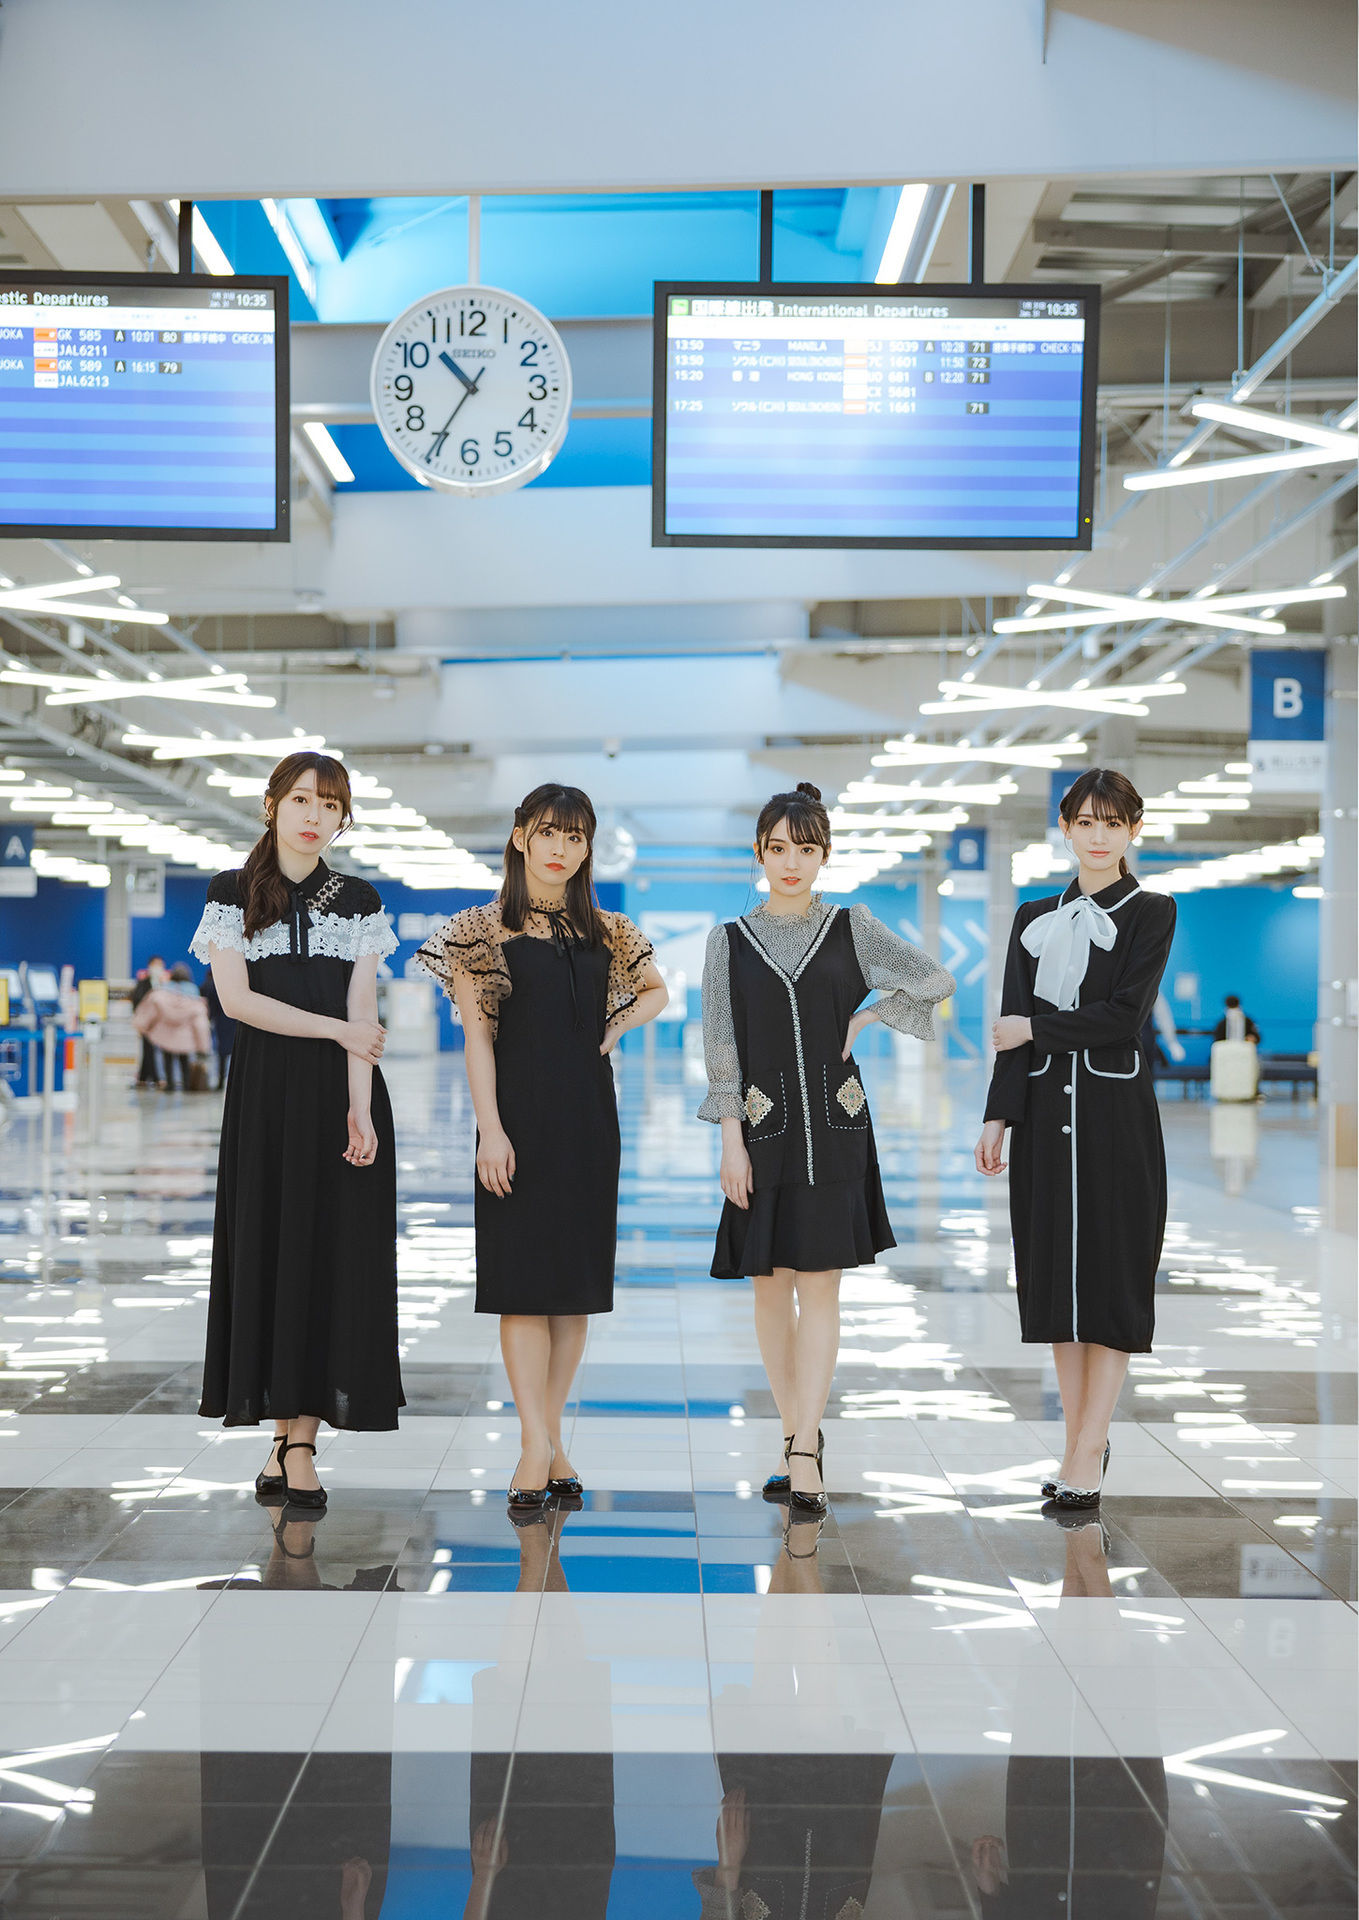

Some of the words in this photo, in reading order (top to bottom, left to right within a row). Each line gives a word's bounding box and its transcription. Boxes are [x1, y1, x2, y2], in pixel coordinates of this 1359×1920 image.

[33, 292, 109, 307] Departures
[236, 294, 267, 307] 10:35
[778, 303, 869, 317] International
[874, 304, 949, 318] Departures
[1047, 303, 1078, 316] 10:35
[460, 310, 487, 336] 12
[58, 329, 73, 341] GK
[79, 330, 102, 342] 585
[115, 330, 125, 342] A
[432, 317, 450, 343] 11
[503, 317, 508, 344] 1
[58, 344, 108, 357] JAL6211
[675, 340, 704, 351] 13:50
[925, 341, 934, 352] A
[972, 342, 985, 353] 71
[403, 342, 430, 369] 10
[452, 349, 496, 359] SEIKO
[520, 340, 538, 366] 2
[115, 361, 125, 373] A
[675, 355, 704, 366] 13:50
[972, 357, 986, 368] 72
[163, 362, 178, 374] 79
[58, 374, 110, 387] JAL6213
[675, 370, 704, 381] 15:20
[971, 372, 985, 384] 71
[394, 374, 413, 401] 9
[528, 374, 547, 401] 3
[675, 402, 703, 412] 17:25
[970, 402, 984, 414] 71
[406, 405, 425, 431] 8
[517, 407, 538, 433] 4
[431, 431, 450, 457] 7
[494, 431, 513, 457] 5
[461, 439, 480, 465] 6
[1273, 677, 1303, 719] B
[5, 835, 26, 860] A
